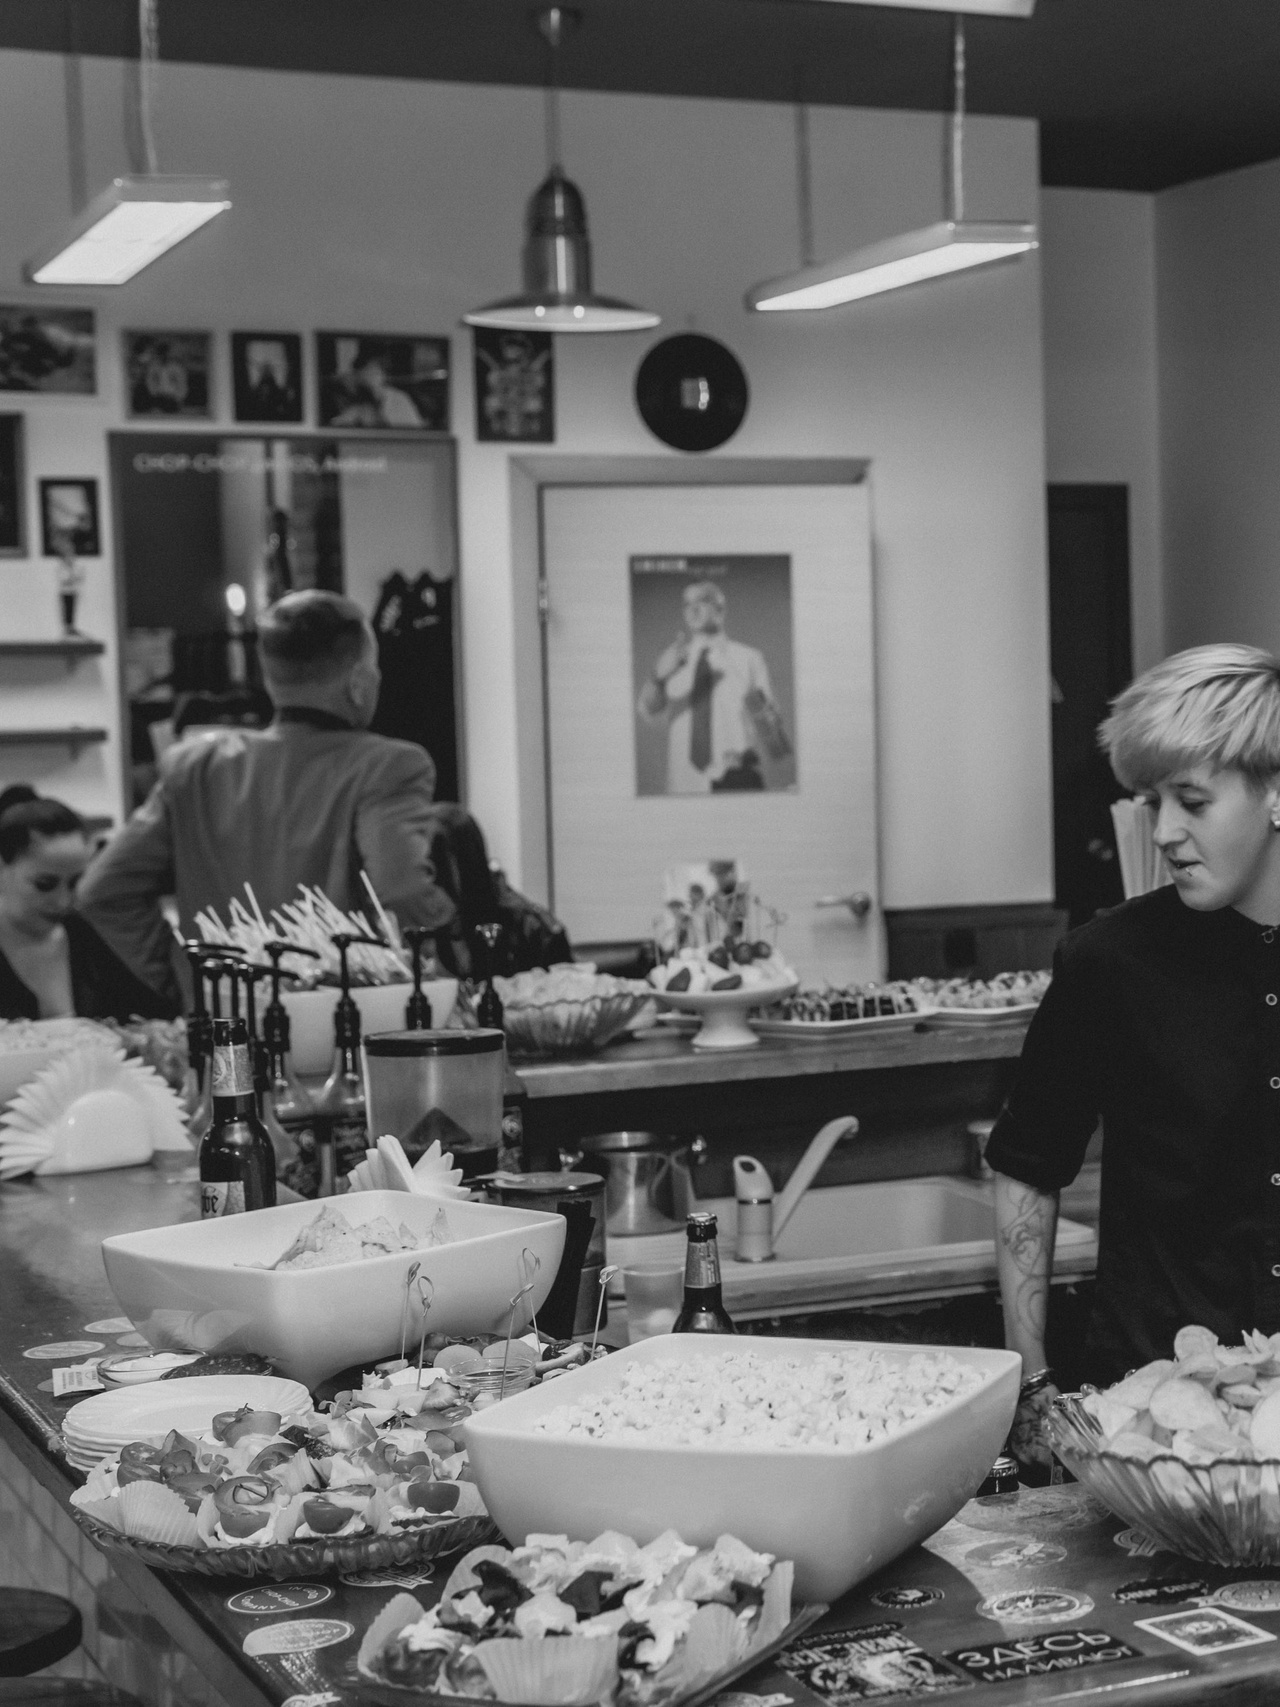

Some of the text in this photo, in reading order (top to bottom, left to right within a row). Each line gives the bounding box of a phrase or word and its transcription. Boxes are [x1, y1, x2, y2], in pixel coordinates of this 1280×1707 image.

[241, 1595, 277, 1609] COMPANY
[260, 1588, 299, 1606] CHOP-CHOP
[957, 1632, 1111, 1668] ЗДЕСЬ
[982, 1645, 1133, 1682] НАЛИВАЮТ
